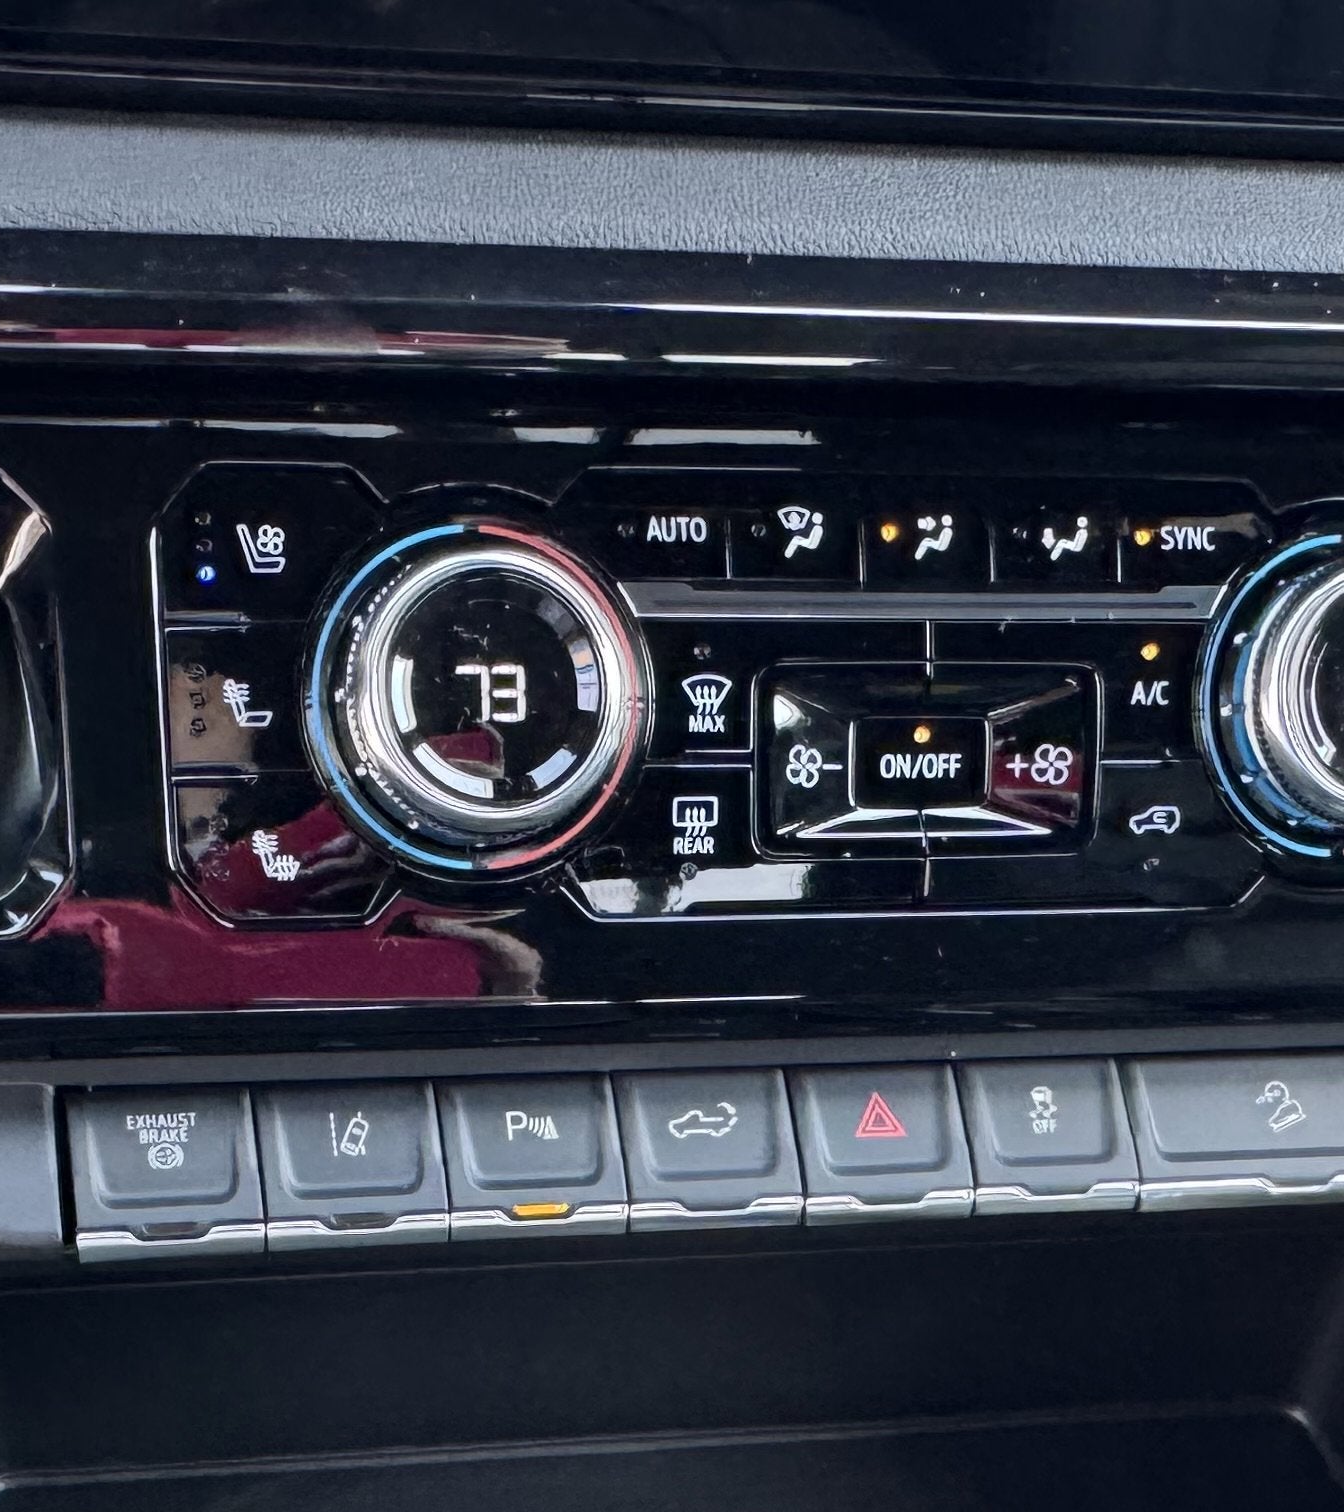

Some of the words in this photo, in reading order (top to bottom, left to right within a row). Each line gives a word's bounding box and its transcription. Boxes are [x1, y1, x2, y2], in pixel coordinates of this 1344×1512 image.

[646, 515, 707, 544] AUTO
[1160, 525, 1216, 552] SYNC
[454, 663, 527, 723] 73
[1130, 680, 1170, 706] A/C
[688, 712, 726, 733] MAX
[879, 752, 962, 780] ON/OFF
[672, 834, 715, 855] REAR
[126, 1112, 197, 1130] EXHAUST
[1032, 1119, 1057, 1135] OFF
[138, 1127, 190, 1144] BRAKE
